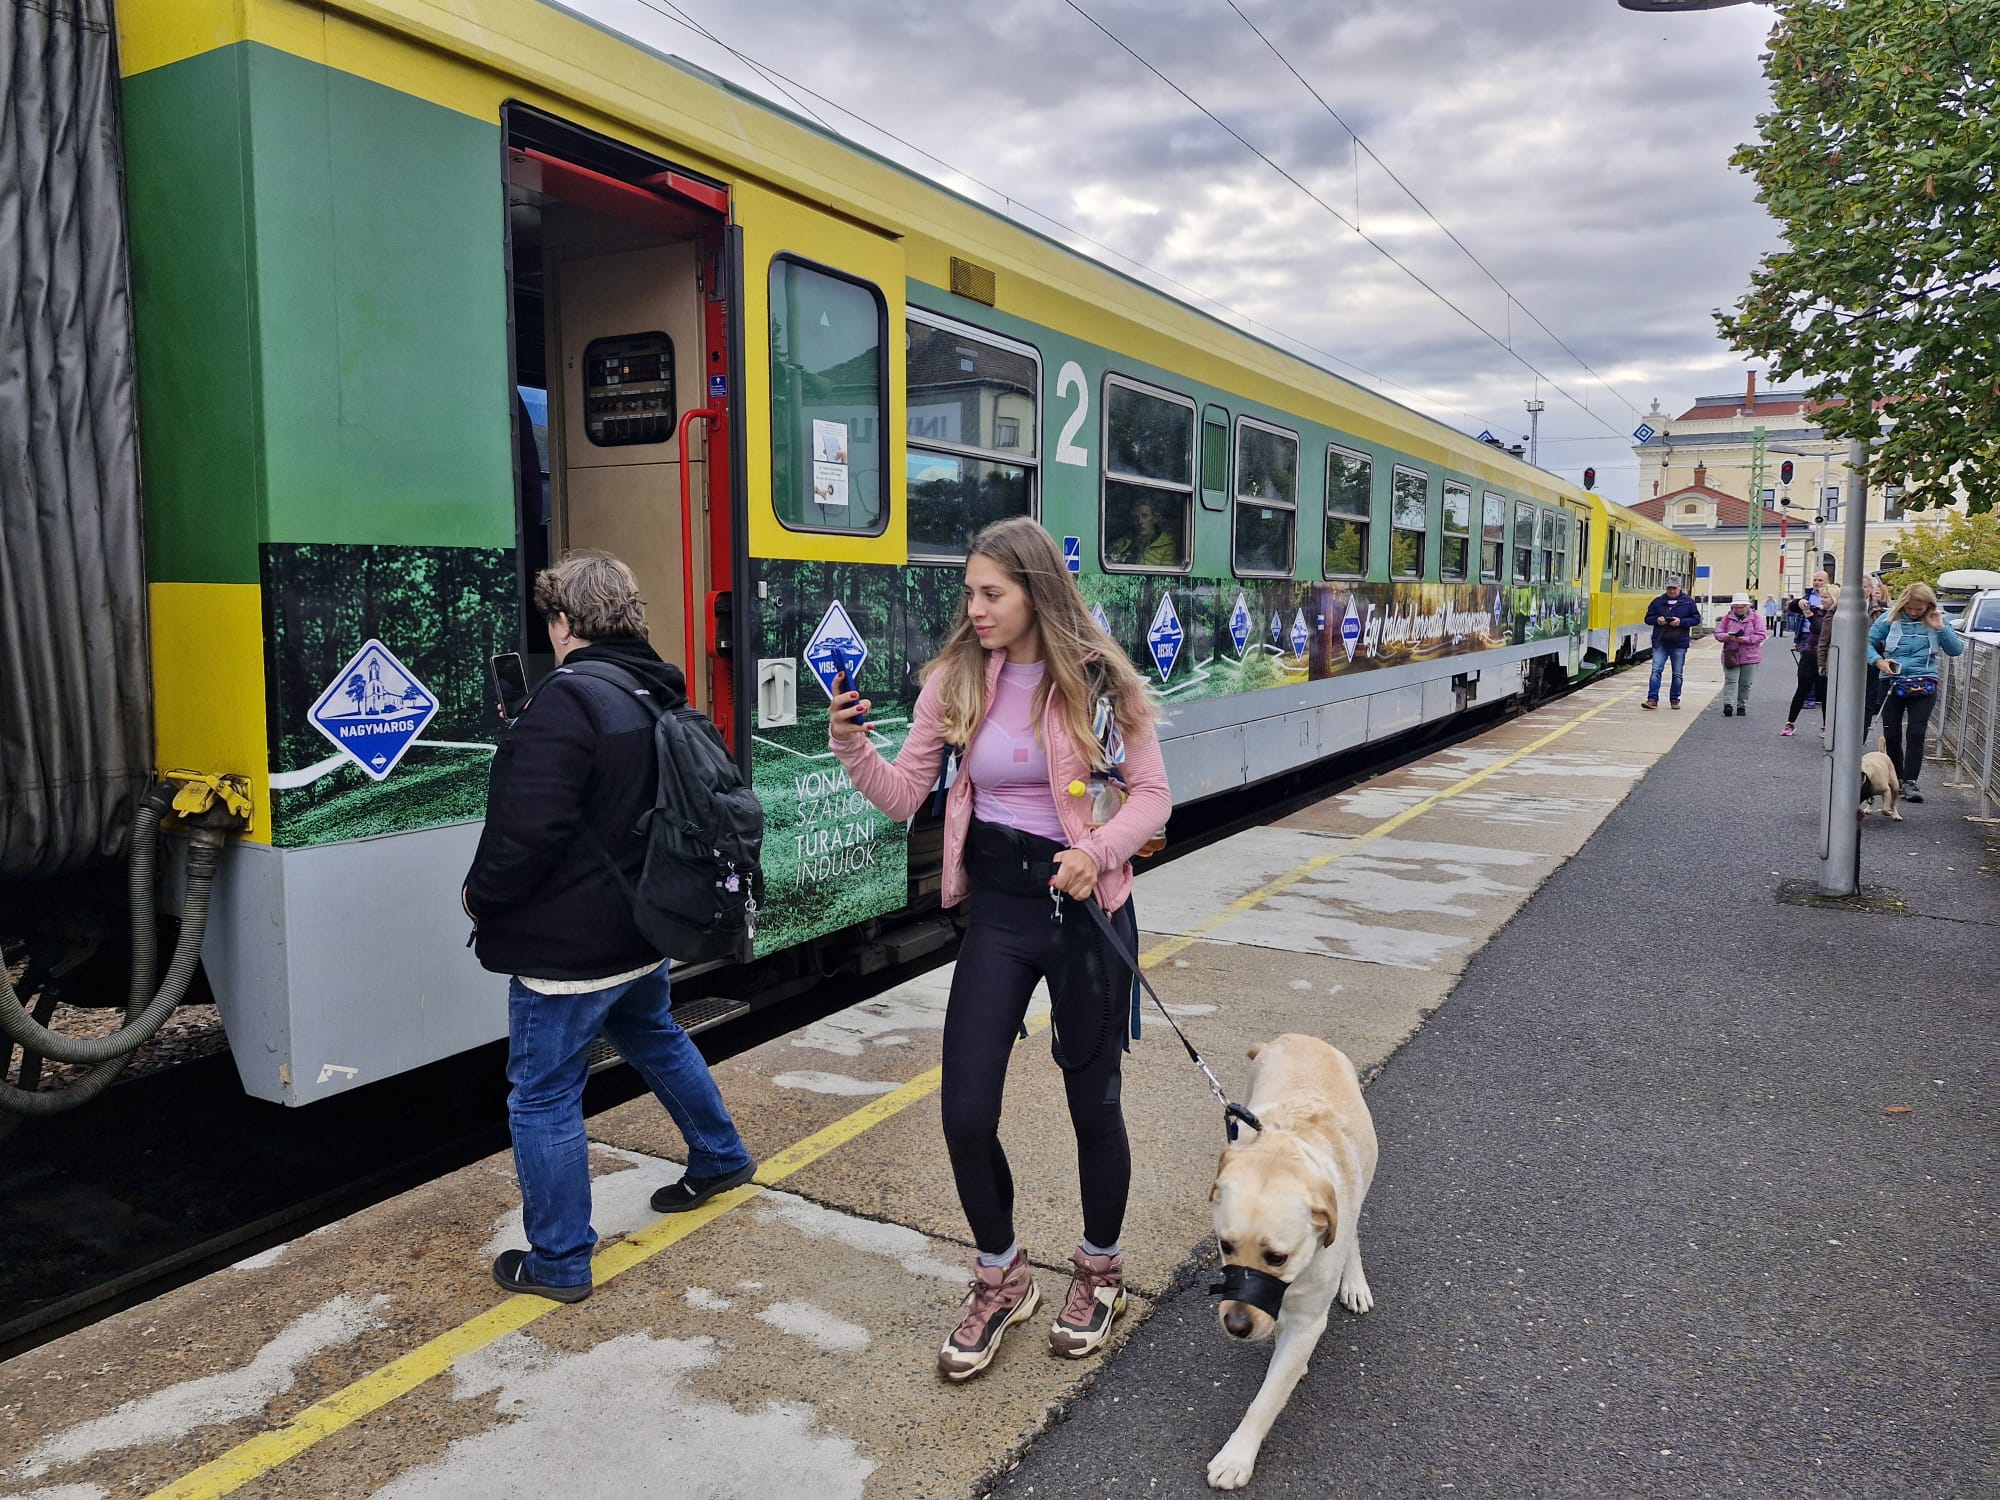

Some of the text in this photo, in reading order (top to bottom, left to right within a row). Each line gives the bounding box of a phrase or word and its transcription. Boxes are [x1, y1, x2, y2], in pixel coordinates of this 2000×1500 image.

[1055, 360, 1089, 467] 2
[1363, 603, 1382, 658] Egy
[818, 659, 854, 674] VISED
[339, 719, 415, 738] NAGYMAROS
[795, 767, 852, 800] VONA
[796, 841, 877, 888] INDULOK
